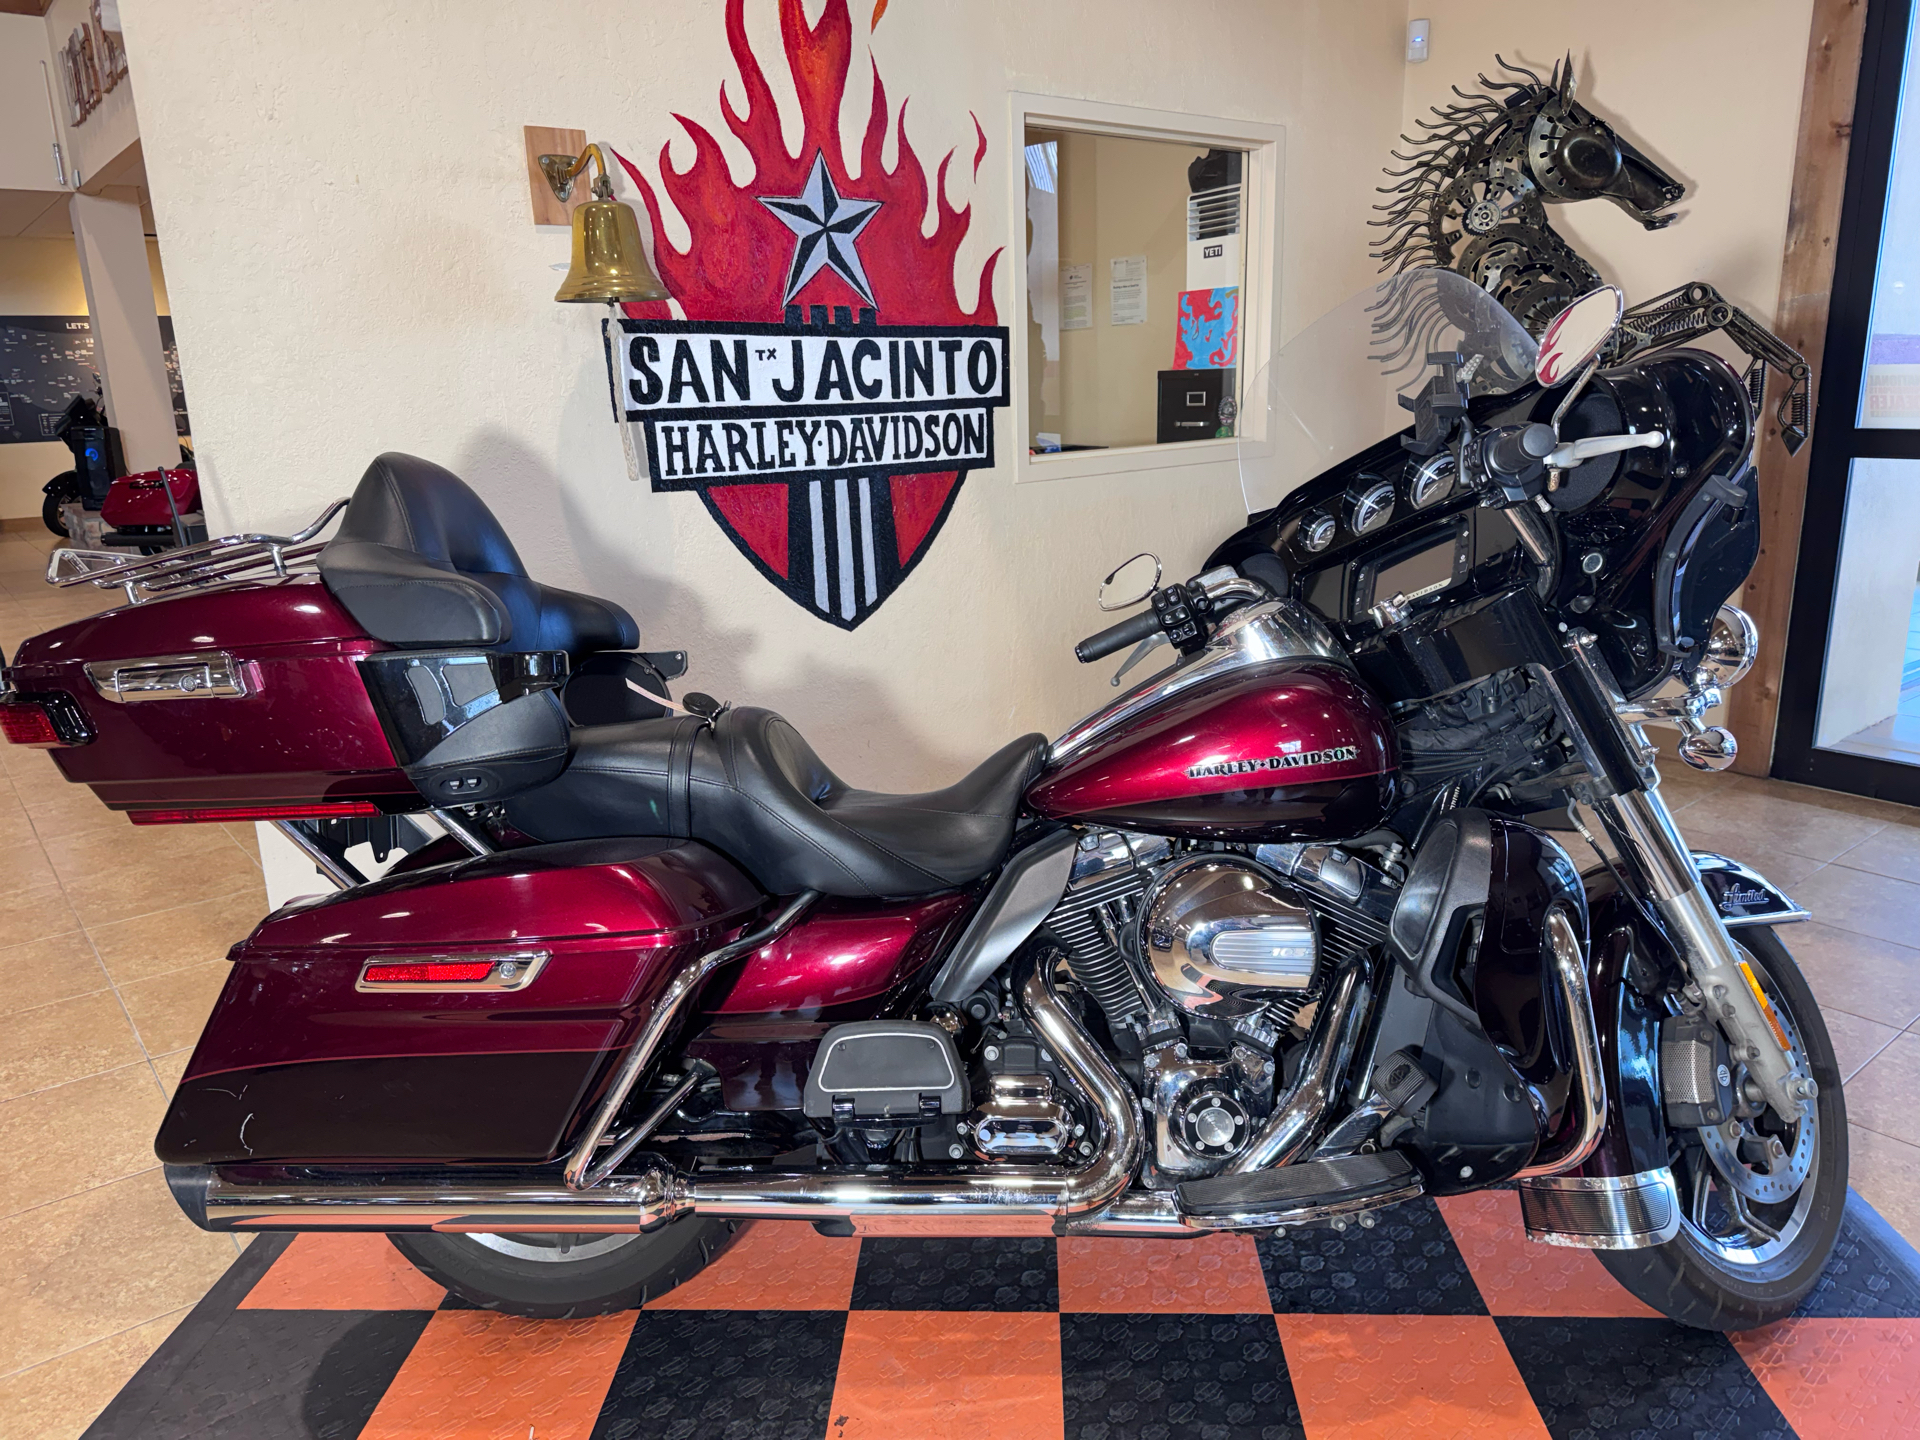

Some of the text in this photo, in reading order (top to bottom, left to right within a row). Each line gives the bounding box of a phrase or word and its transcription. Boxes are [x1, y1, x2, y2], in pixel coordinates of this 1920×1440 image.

[1204, 246, 1222, 257] YETI
[66, 322, 90, 330] LET'S
[628, 336, 997, 405] SAN TX JACINTO
[1406, 582, 1444, 600] DAVIDSON
[1718, 882, 1770, 912] Limited
